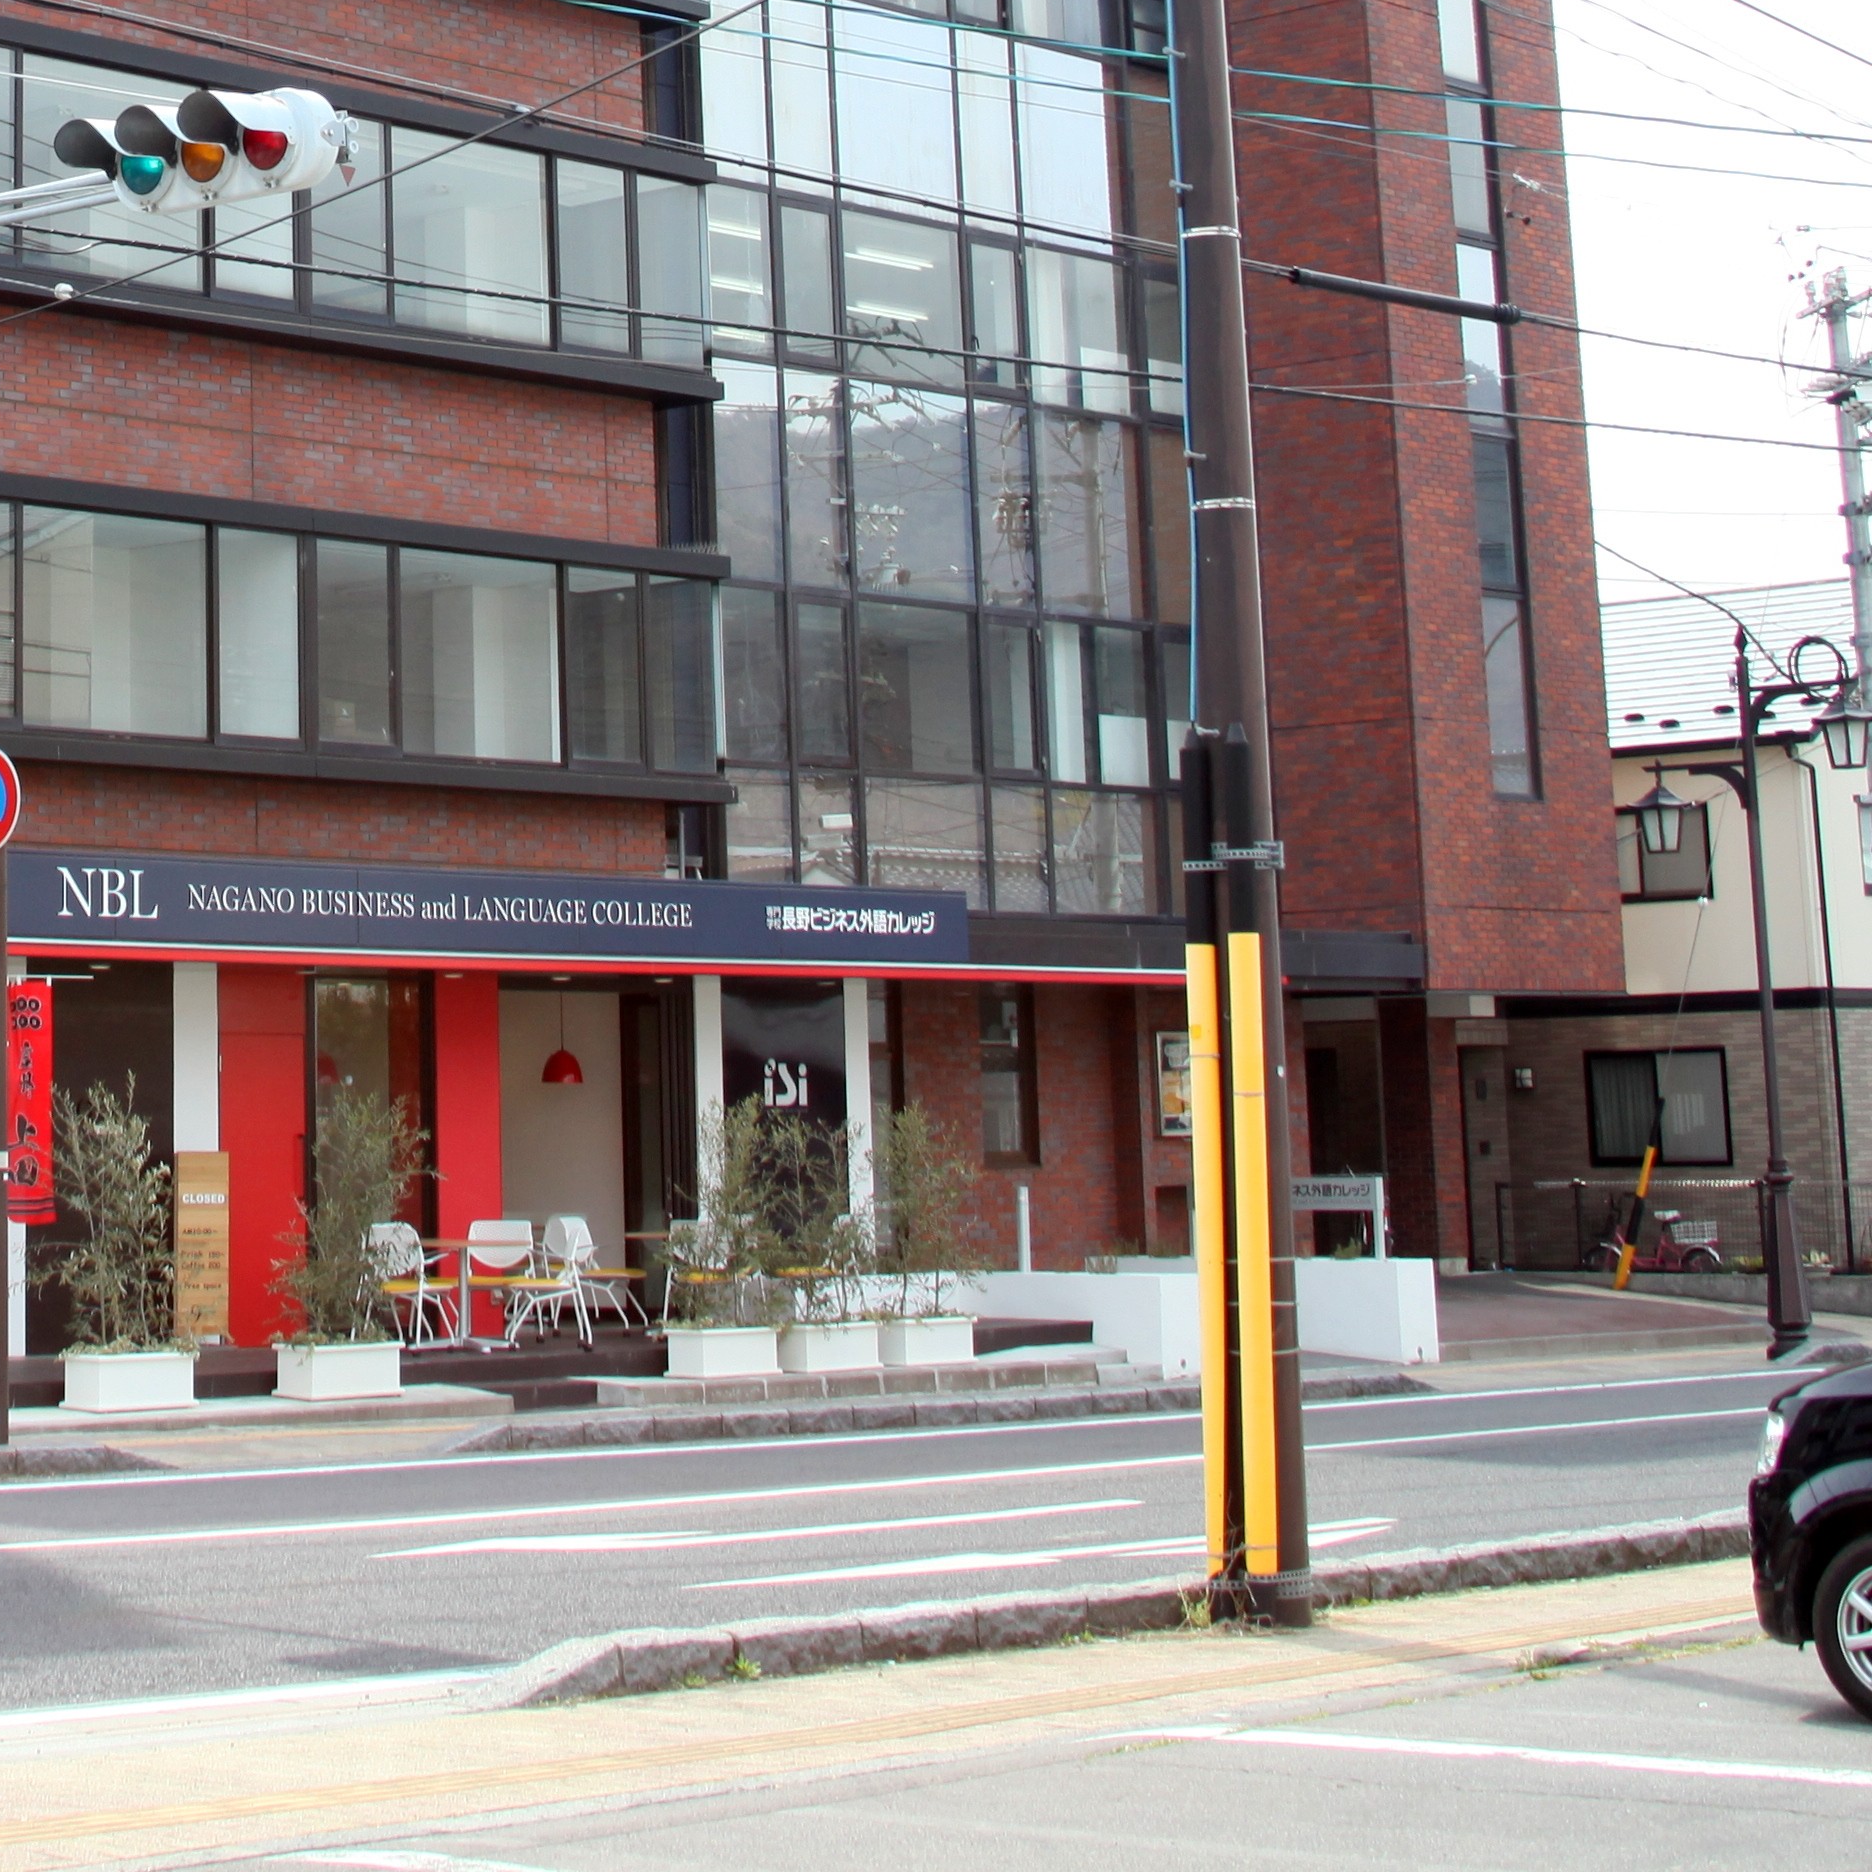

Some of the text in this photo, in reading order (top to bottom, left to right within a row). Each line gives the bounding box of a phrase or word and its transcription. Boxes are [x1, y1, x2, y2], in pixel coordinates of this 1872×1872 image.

[56, 866, 158, 919] NBL
[187, 883, 693, 928] NAGANO BUSINESS and LANGUAGE COLLEGE
[782, 906, 935, 934] 長野ビジネス外語カレッジ
[182, 1193, 225, 1204] CLOSED
